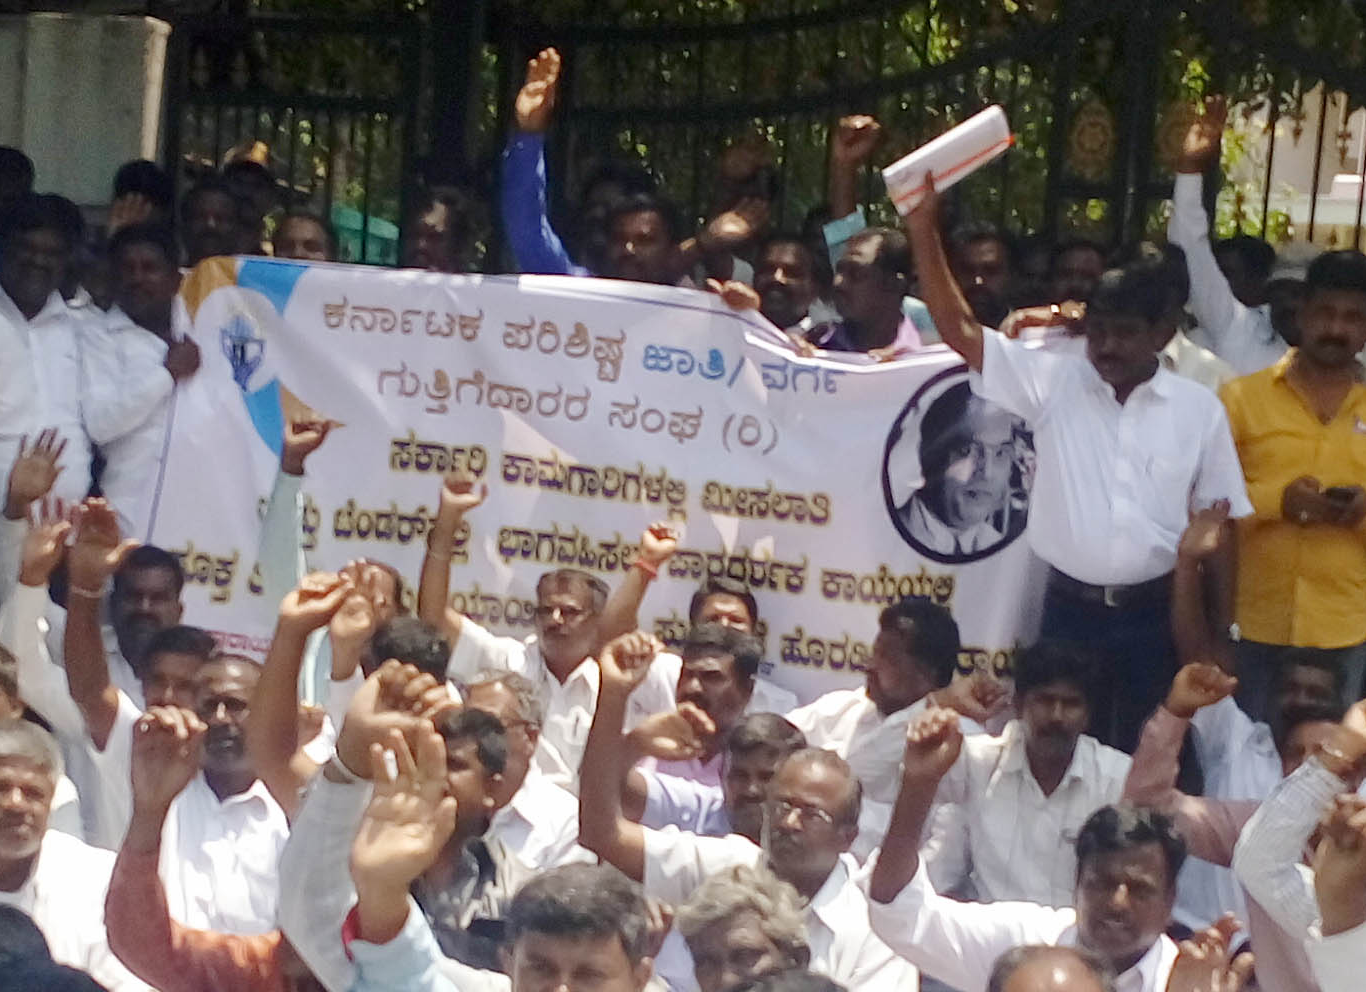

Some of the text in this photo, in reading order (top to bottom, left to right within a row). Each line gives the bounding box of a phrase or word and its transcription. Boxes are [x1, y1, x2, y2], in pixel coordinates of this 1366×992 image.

[323, 296, 483, 342] ಕರ್ನಾಟಕ
[502, 315, 627, 383] ಪರಿಶಿಷ್ಟ
[378, 361, 779, 456] ಗುತ್ತಿಗೆದಾರರ ಸಂಘ (ರಿ)
[390, 429, 833, 525] ಸರ್ಕಾರಿ ಕಾಮಗಾರಿಗಳಲ್ಲಿ ಮೀಸಲಾತಿ
